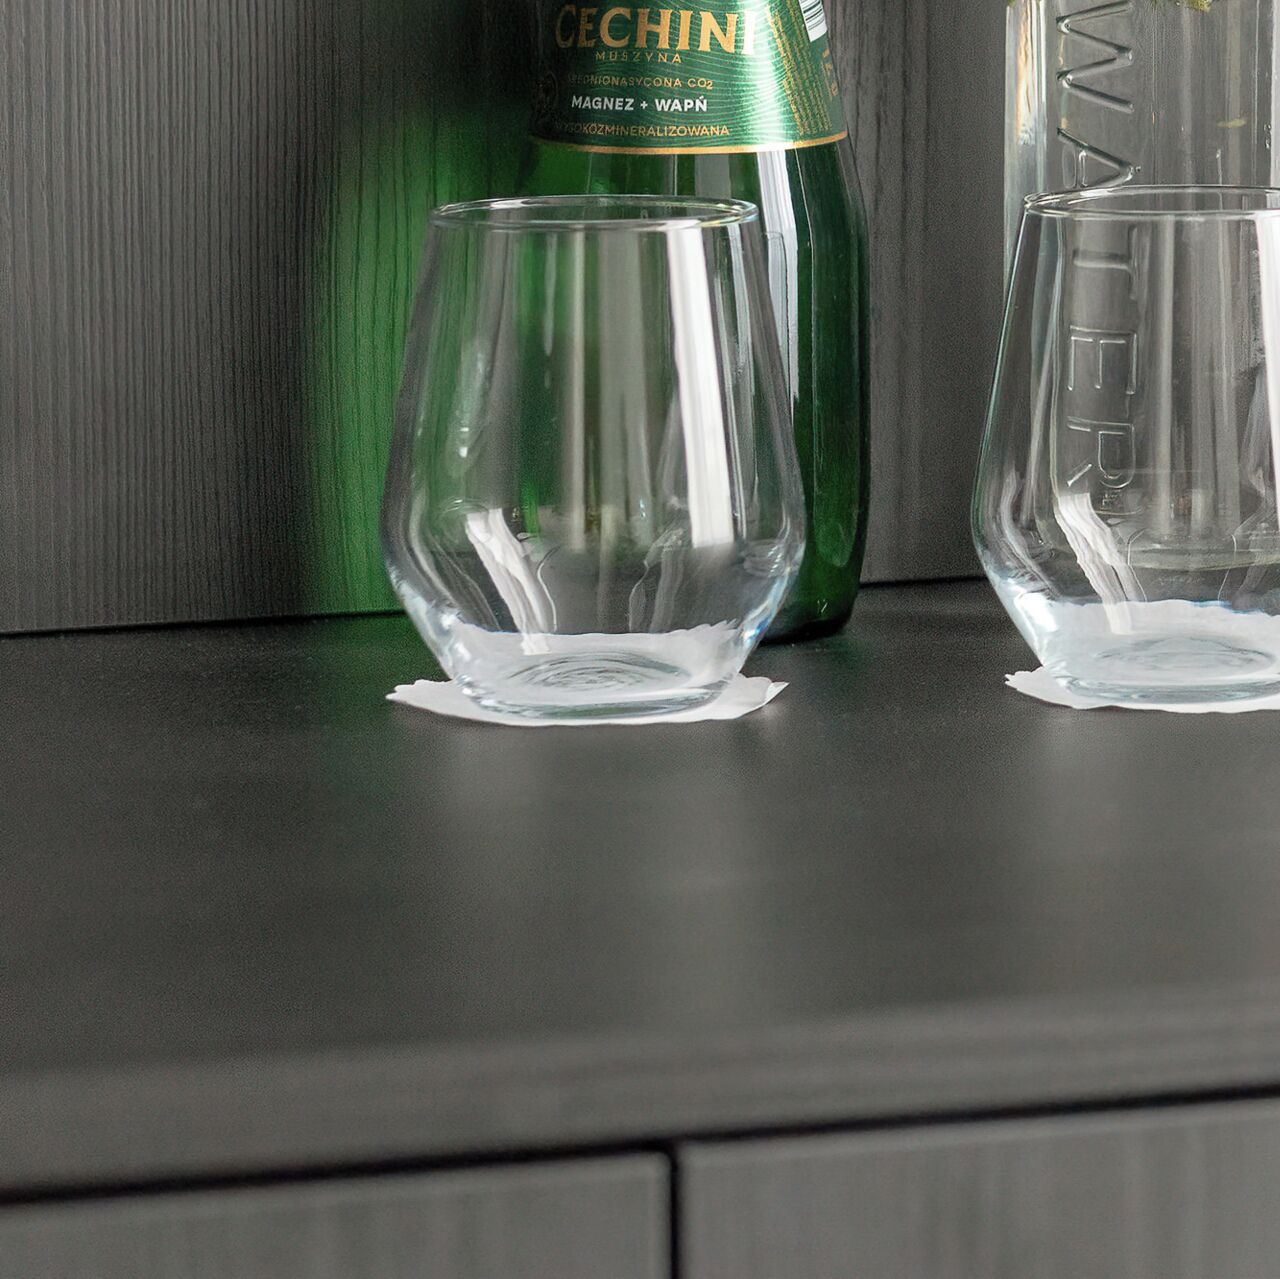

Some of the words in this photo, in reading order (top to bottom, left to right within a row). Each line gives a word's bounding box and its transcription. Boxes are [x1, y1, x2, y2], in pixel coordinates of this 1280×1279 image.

[555, 4, 756, 55] CECHINI
[571, 95, 634, 111] MAGNEZ
[640, 101, 649, 110] +
[655, 96, 708, 112] WAPŃ
